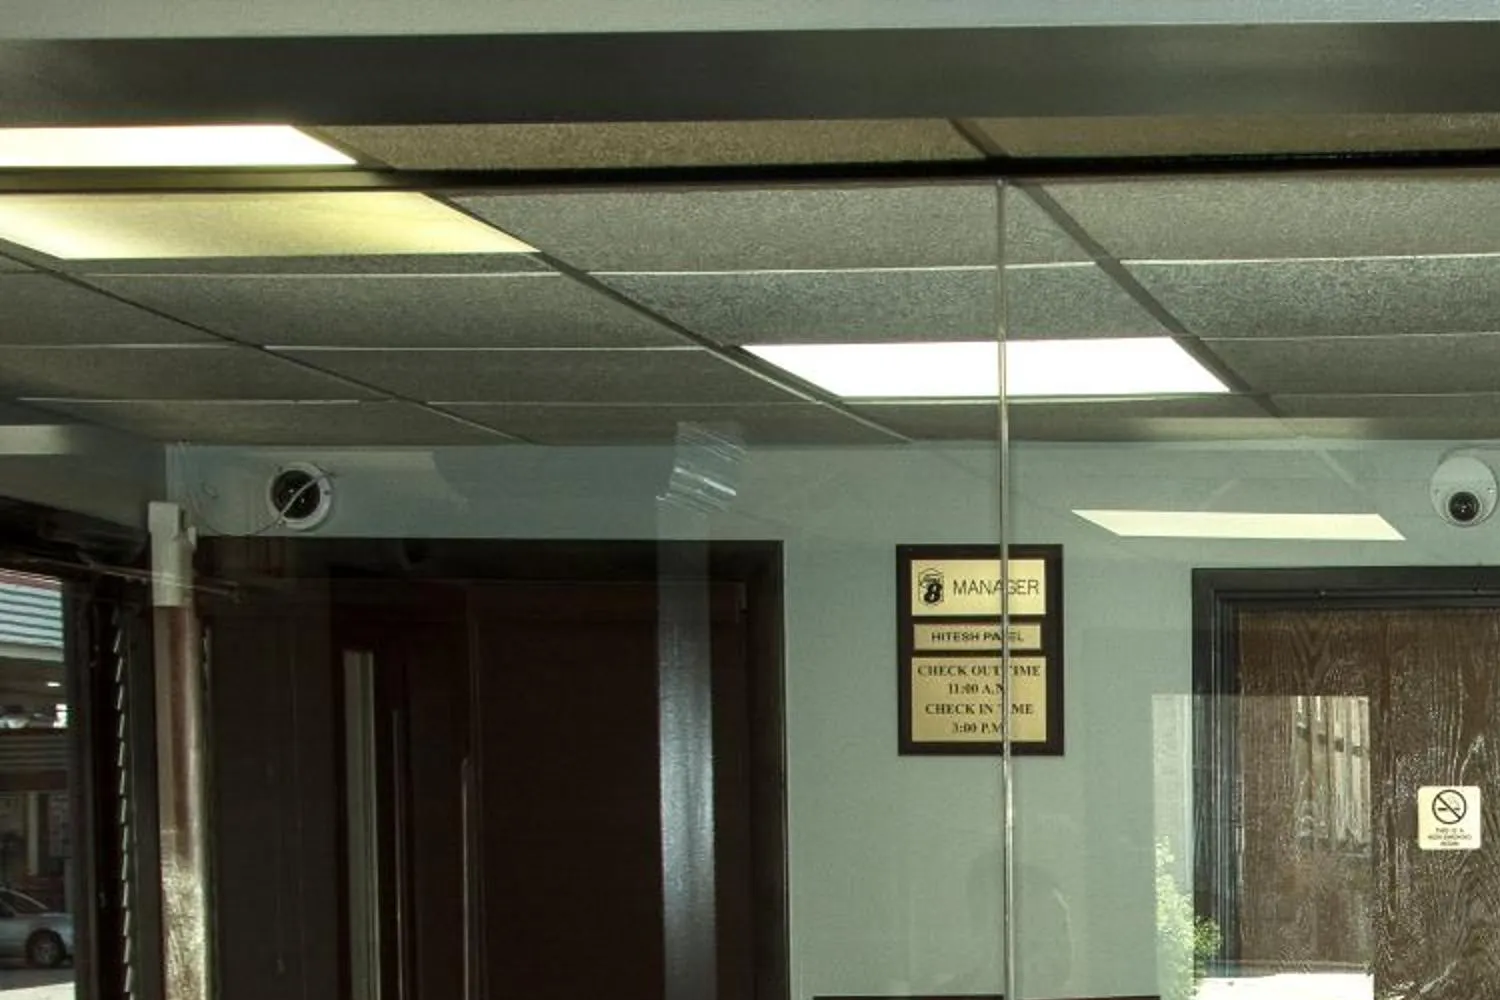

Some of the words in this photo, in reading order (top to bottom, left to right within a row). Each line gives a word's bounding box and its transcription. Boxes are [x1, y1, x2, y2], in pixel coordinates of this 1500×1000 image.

[953, 579, 1040, 595] MANAGER
[931, 631, 979, 641] HITESH
[983, 631, 1025, 641] PAEL
[917, 665, 968, 677] CHECK
[971, 665, 1001, 676] OUT
[1007, 665, 1041, 676] IME
[948, 683, 979, 695] 11:00
[925, 703, 975, 715] CHECK
[979, 703, 994, 715] IN
